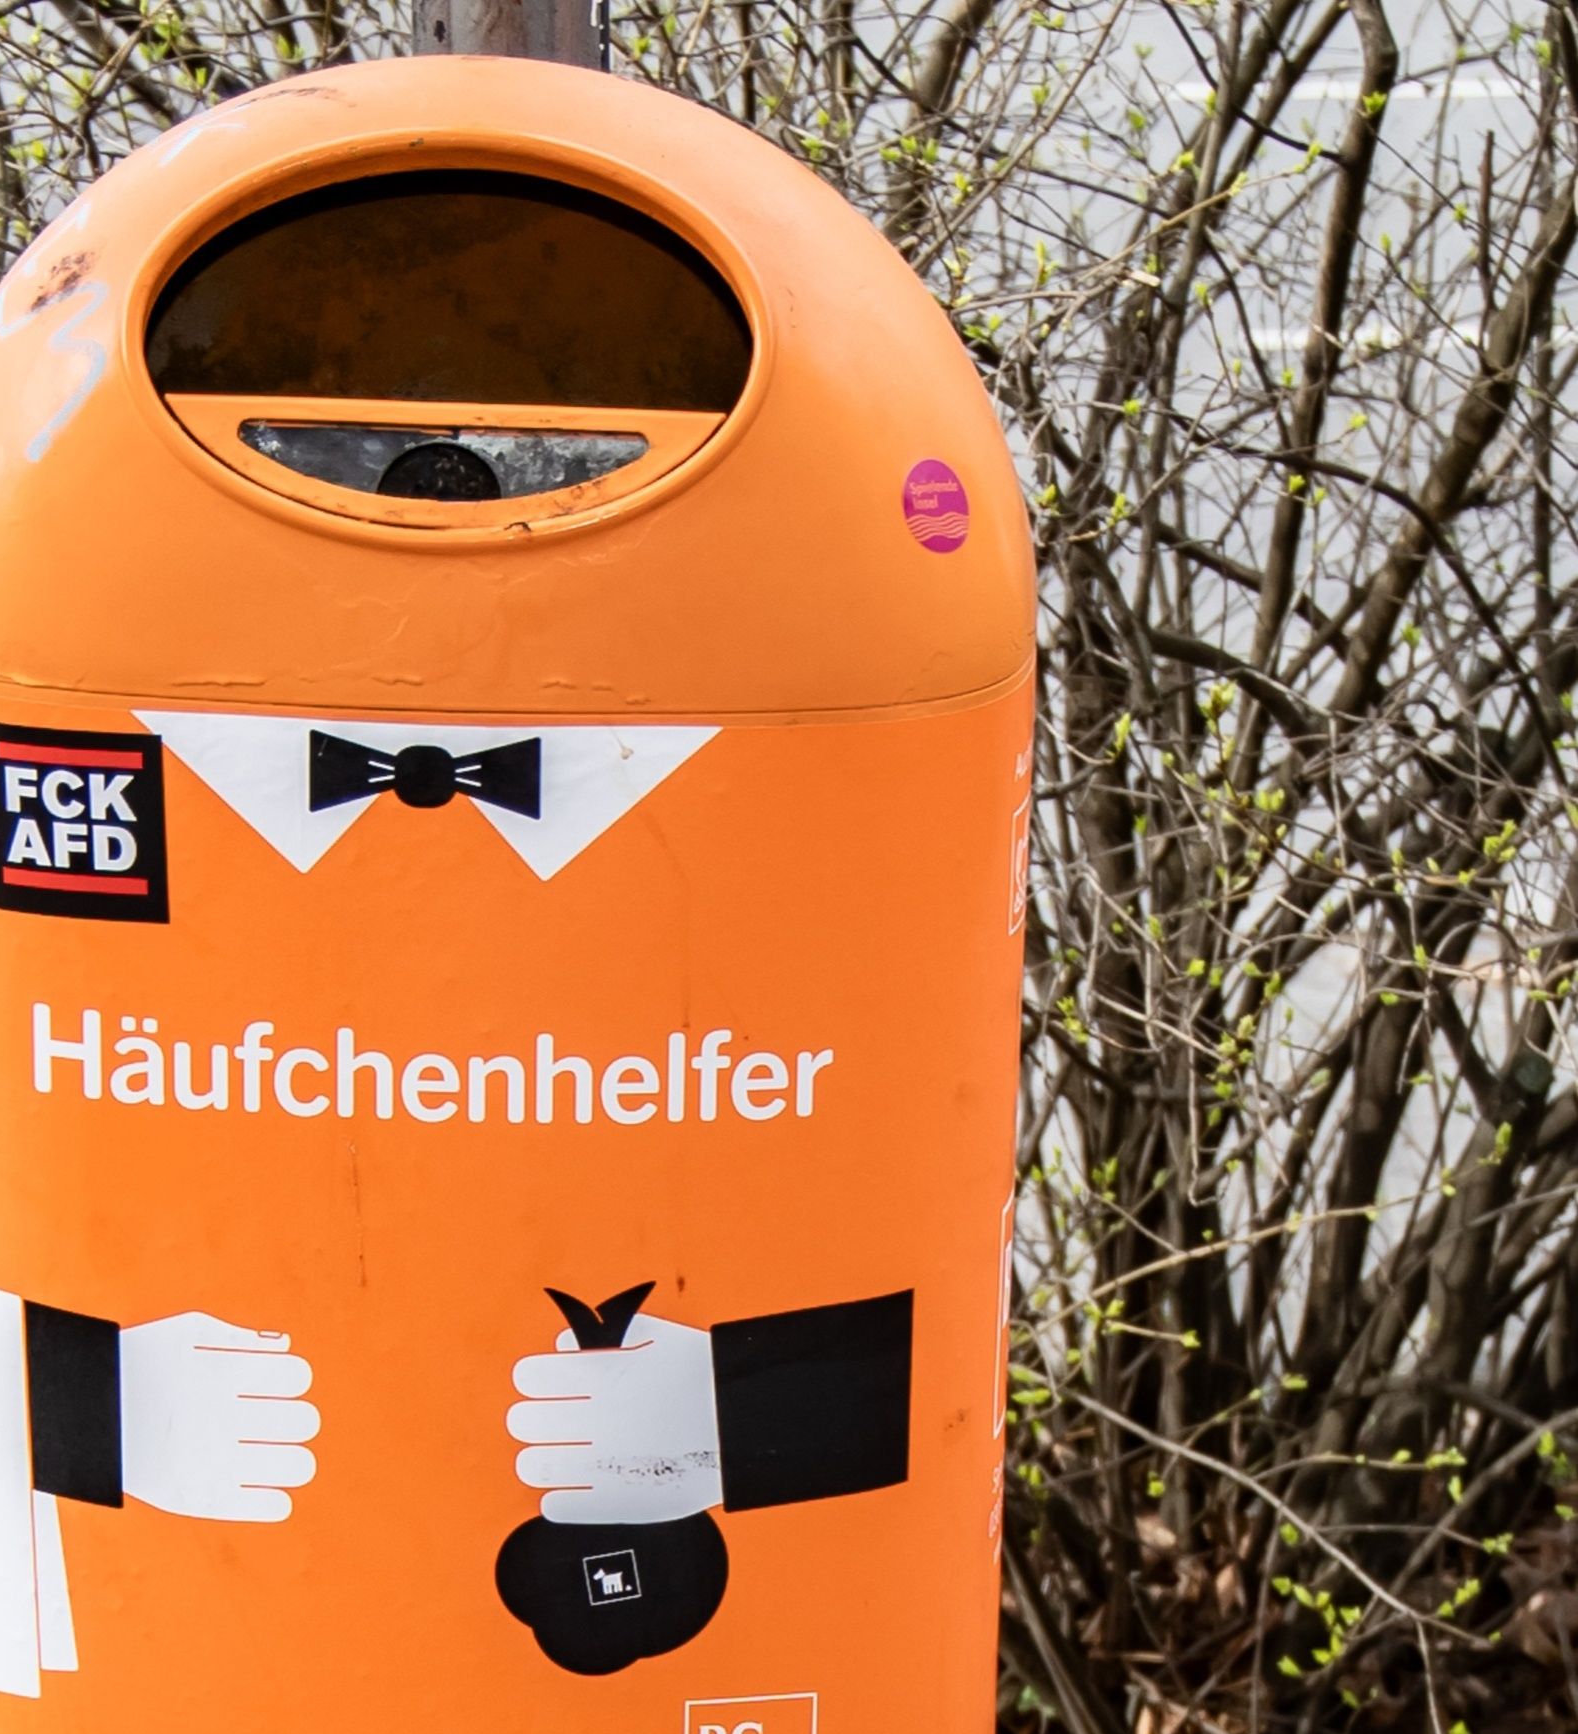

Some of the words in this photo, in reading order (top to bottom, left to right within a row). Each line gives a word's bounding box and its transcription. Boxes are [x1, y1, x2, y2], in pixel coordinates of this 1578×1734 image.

[5, 766, 137, 822] FCK
[7, 818, 137, 871] AFD
[33, 1003, 833, 1124] Häufchenhelfer
